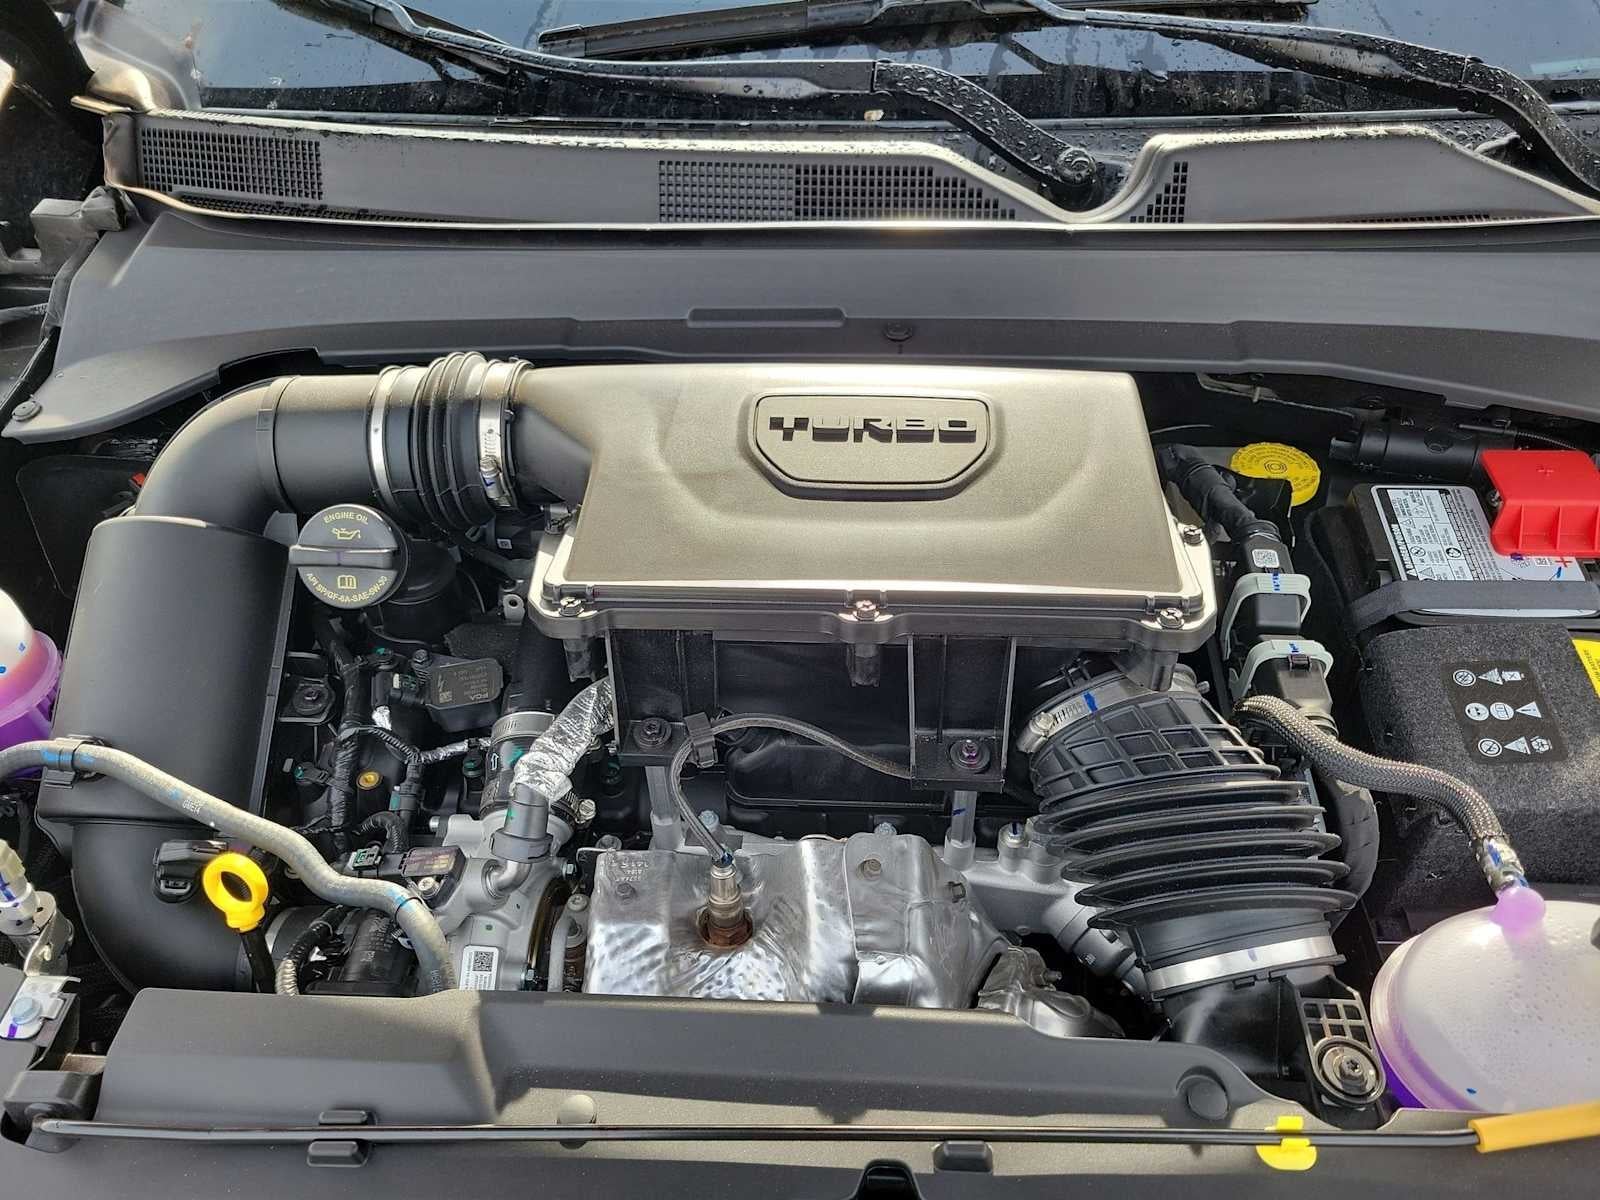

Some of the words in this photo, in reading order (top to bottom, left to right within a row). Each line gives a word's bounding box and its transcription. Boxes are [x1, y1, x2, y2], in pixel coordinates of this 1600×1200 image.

[769, 416, 977, 443] TURBO
[324, 511, 354, 524] ENGINE
[356, 513, 368, 525] OIL
[306, 573, 318, 586] API
